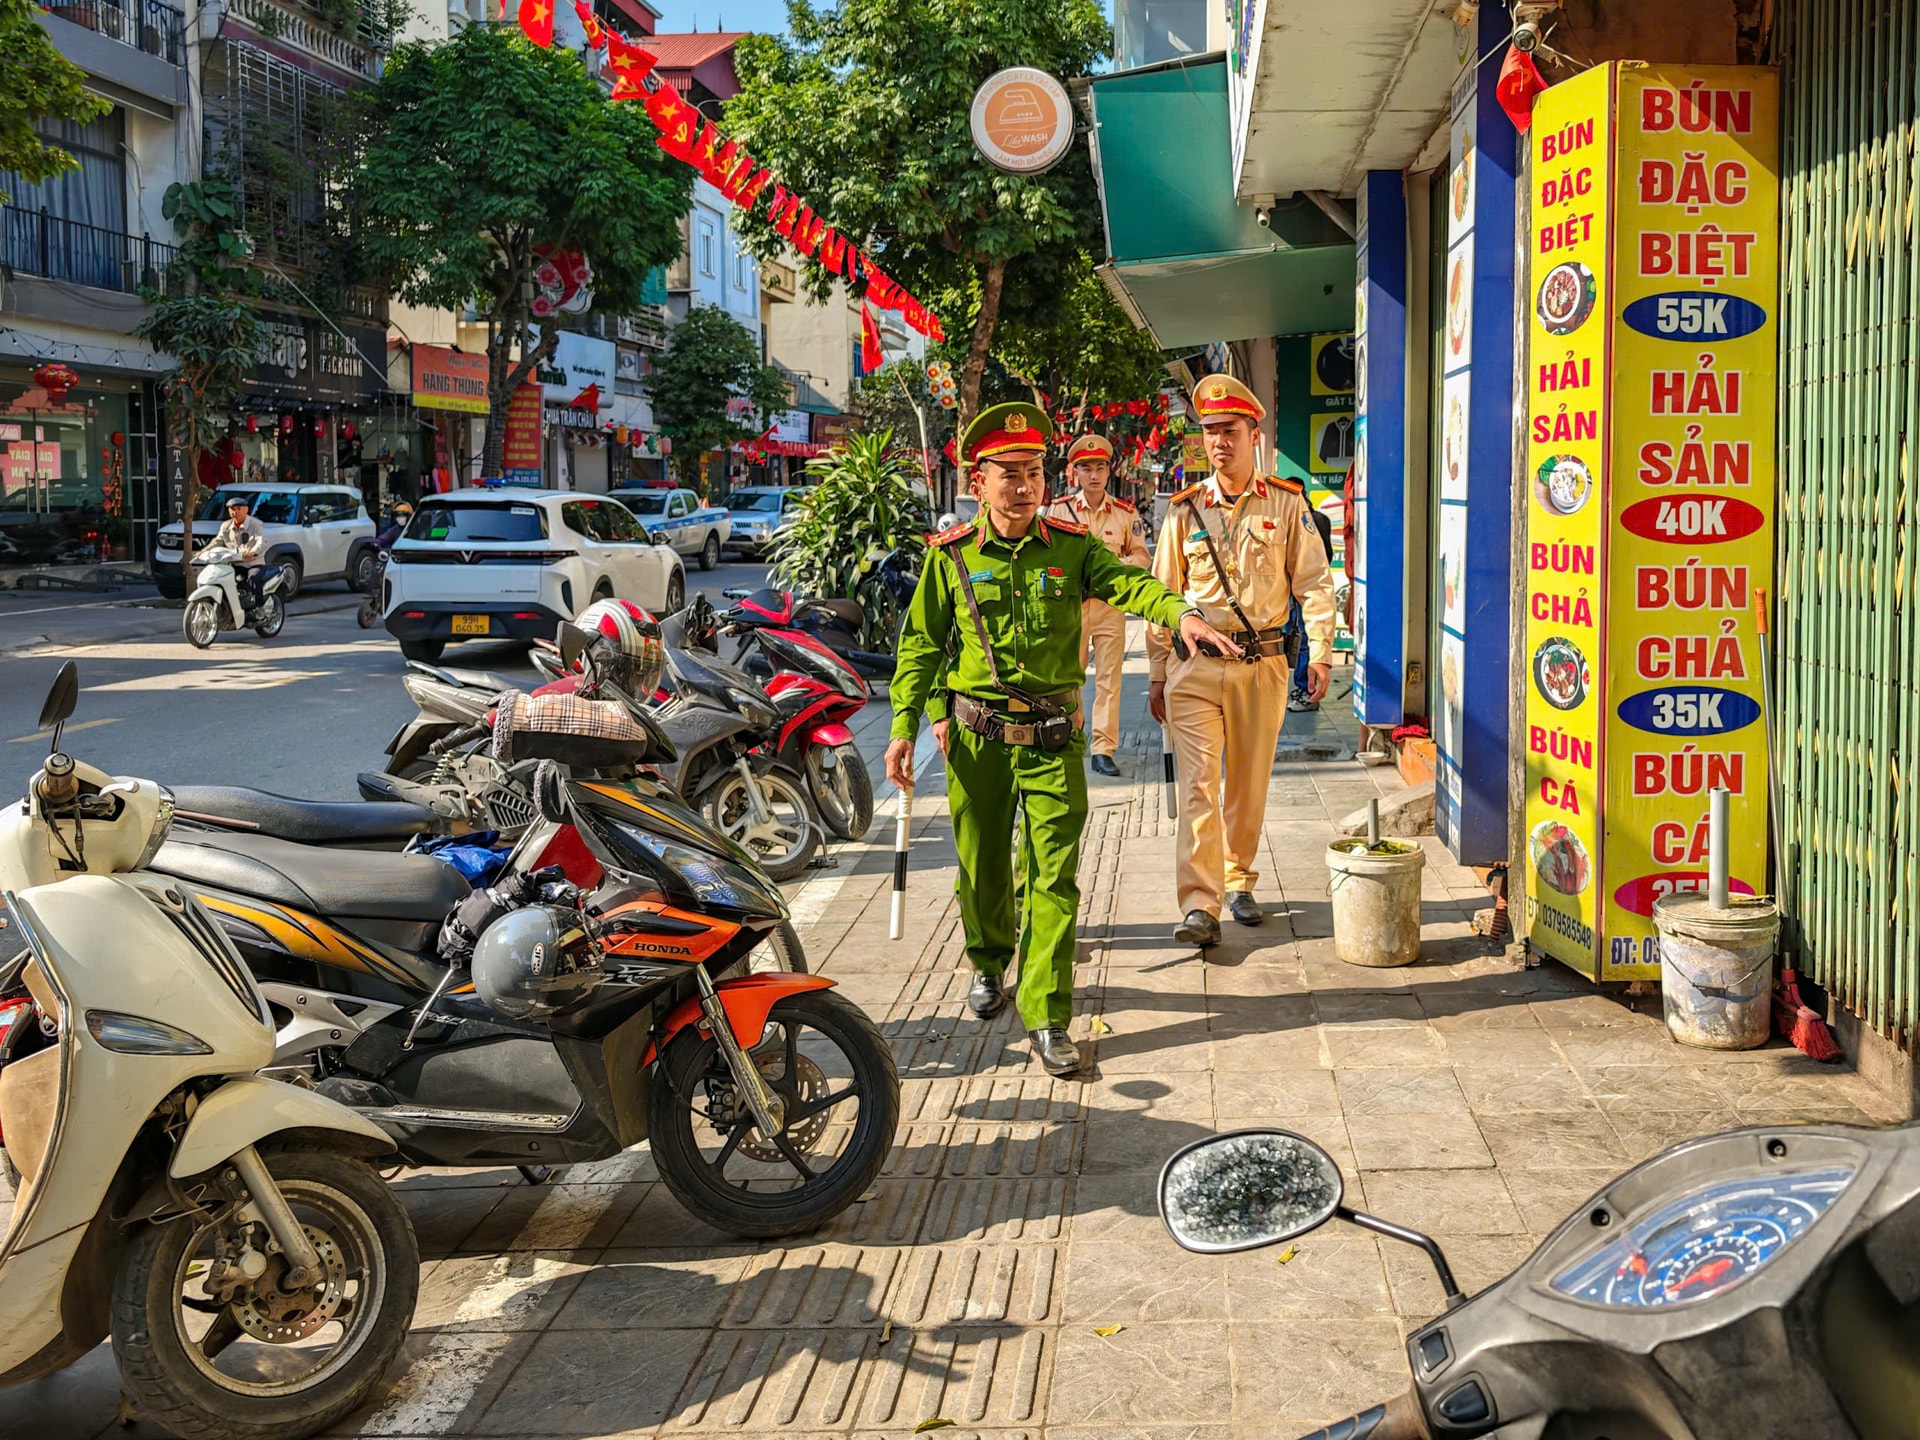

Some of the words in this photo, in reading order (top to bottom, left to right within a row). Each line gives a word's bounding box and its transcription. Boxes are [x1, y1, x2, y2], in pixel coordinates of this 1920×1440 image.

[1641, 81, 1752, 134] BÚN
[1541, 117, 1594, 163] BÚN
[1541, 167, 1592, 209] ĐẶC
[1639, 151, 1748, 216] ĐẶC
[1540, 213, 1594, 254] BIỆT
[1640, 223, 1757, 286] BIỆT
[1656, 298, 1727, 334] 55K
[423, 369, 450, 392] HÀNG
[1539, 350, 1591, 393] HẢI
[1650, 352, 1741, 416] HẢI
[1533, 403, 1597, 443] SẢN
[1638, 423, 1751, 487] SẢN
[1655, 500, 1726, 536] 40K
[1531, 538, 1594, 574] BÚN
[1635, 558, 1749, 611] BÚN
[462, 615, 479, 624] 99H
[1531, 587, 1593, 628] CHẢ
[456, 624, 485, 633] 040.35
[1637, 619, 1746, 681] CHẢ
[1652, 693, 1723, 729] 35K
[1530, 726, 1592, 770] BÚN
[1632, 745, 1745, 797] BÚN
[1540, 776, 1580, 816] CÁ
[1542, 903, 1592, 951] 0379585548
[634, 942, 692, 956] HONDA
[1609, 937, 1638, 965] ĐT:
